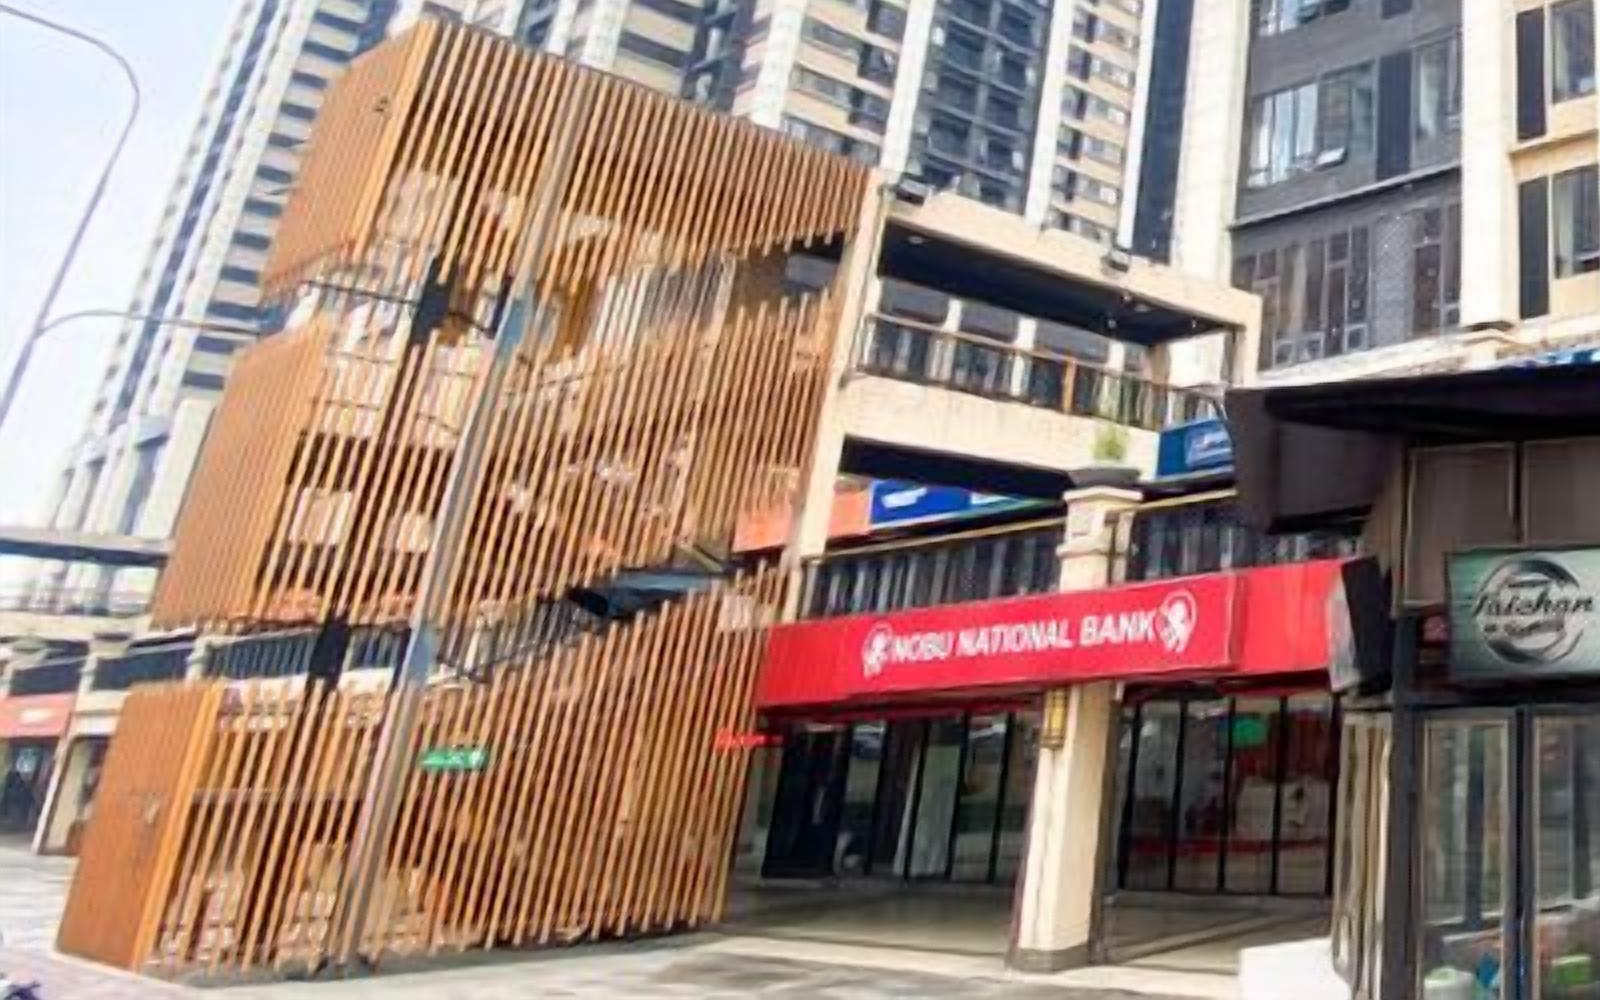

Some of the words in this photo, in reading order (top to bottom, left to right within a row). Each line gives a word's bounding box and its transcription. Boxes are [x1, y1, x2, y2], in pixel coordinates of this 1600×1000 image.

[889, 630, 954, 664] NOBU
[954, 618, 1073, 657] NATIONAL
[1080, 609, 1157, 646] BANK
